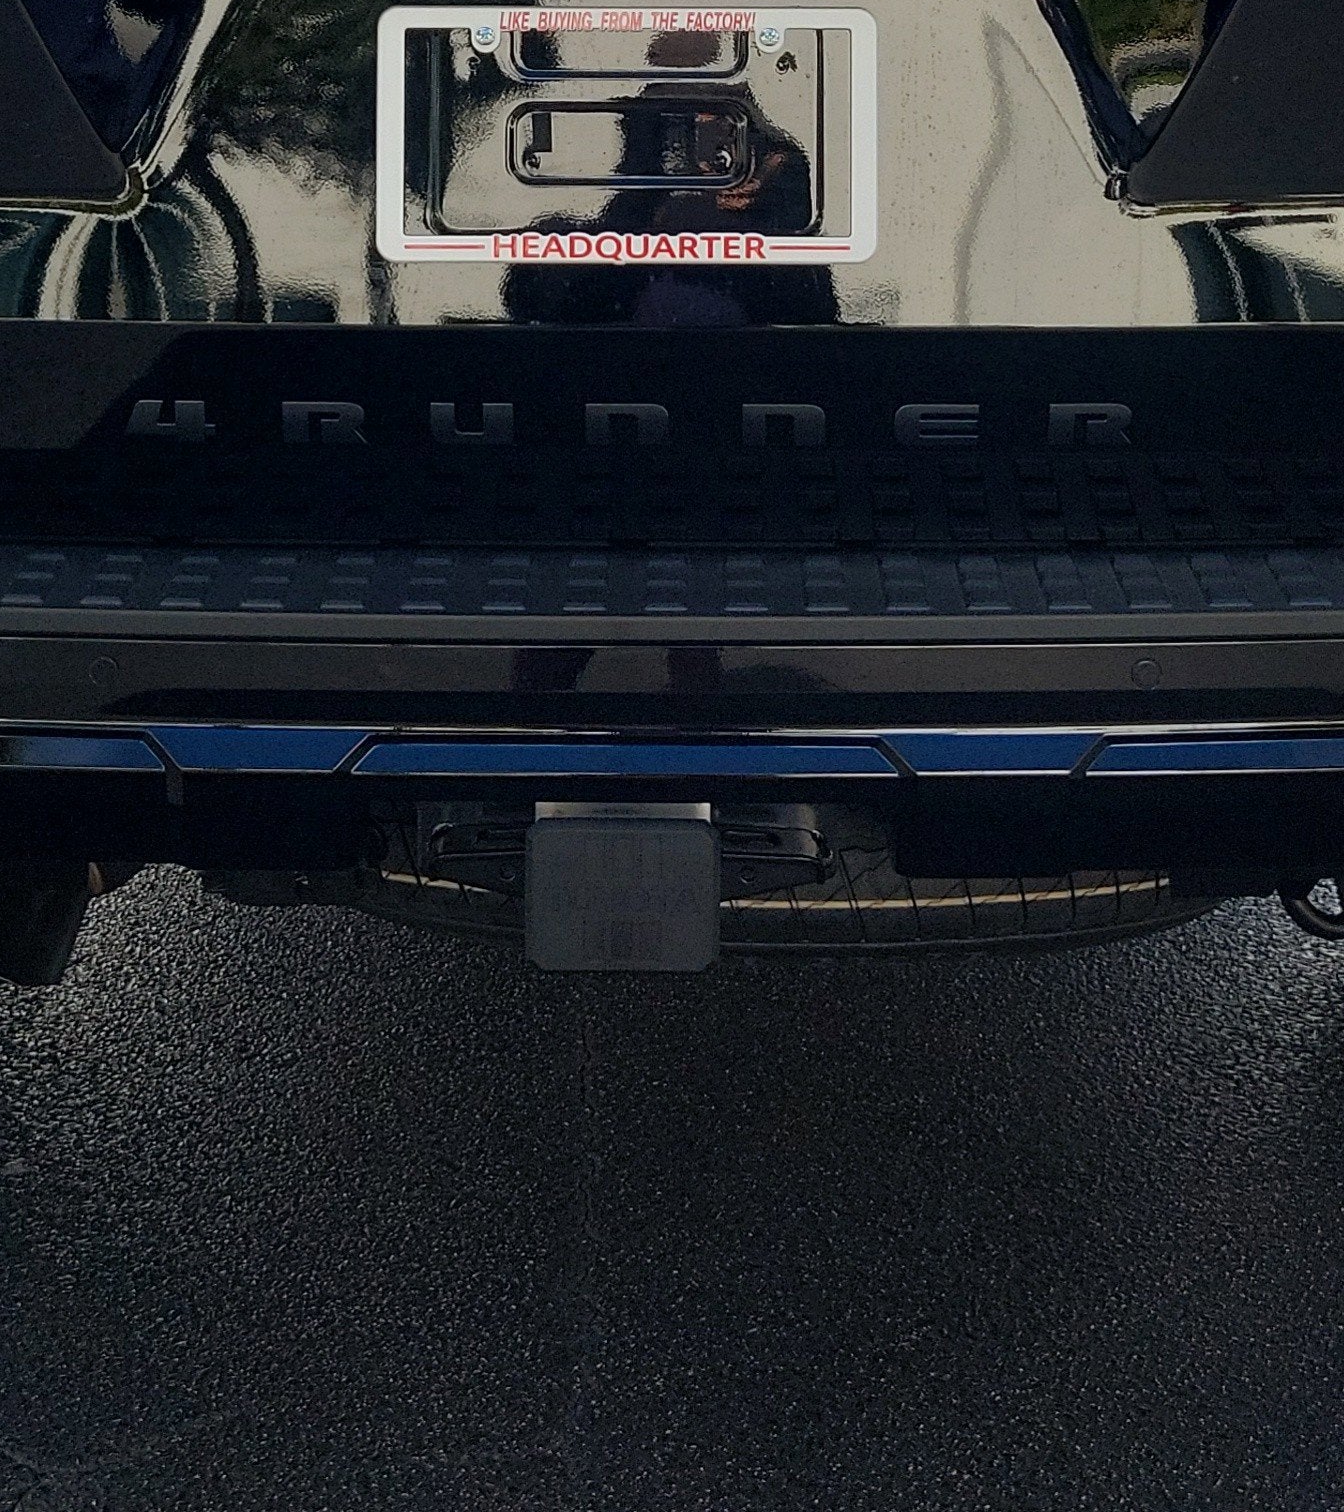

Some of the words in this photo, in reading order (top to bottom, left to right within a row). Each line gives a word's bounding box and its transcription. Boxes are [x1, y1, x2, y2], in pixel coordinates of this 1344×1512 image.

[500, 11, 531, 31] LIKE
[537, 11, 593, 31] BUYING
[600, 11, 644, 31] FROM
[651, 11, 680, 31] THE
[686, 11, 756, 31] FACTORY!
[492, 234, 766, 261] HEADQUARTER
